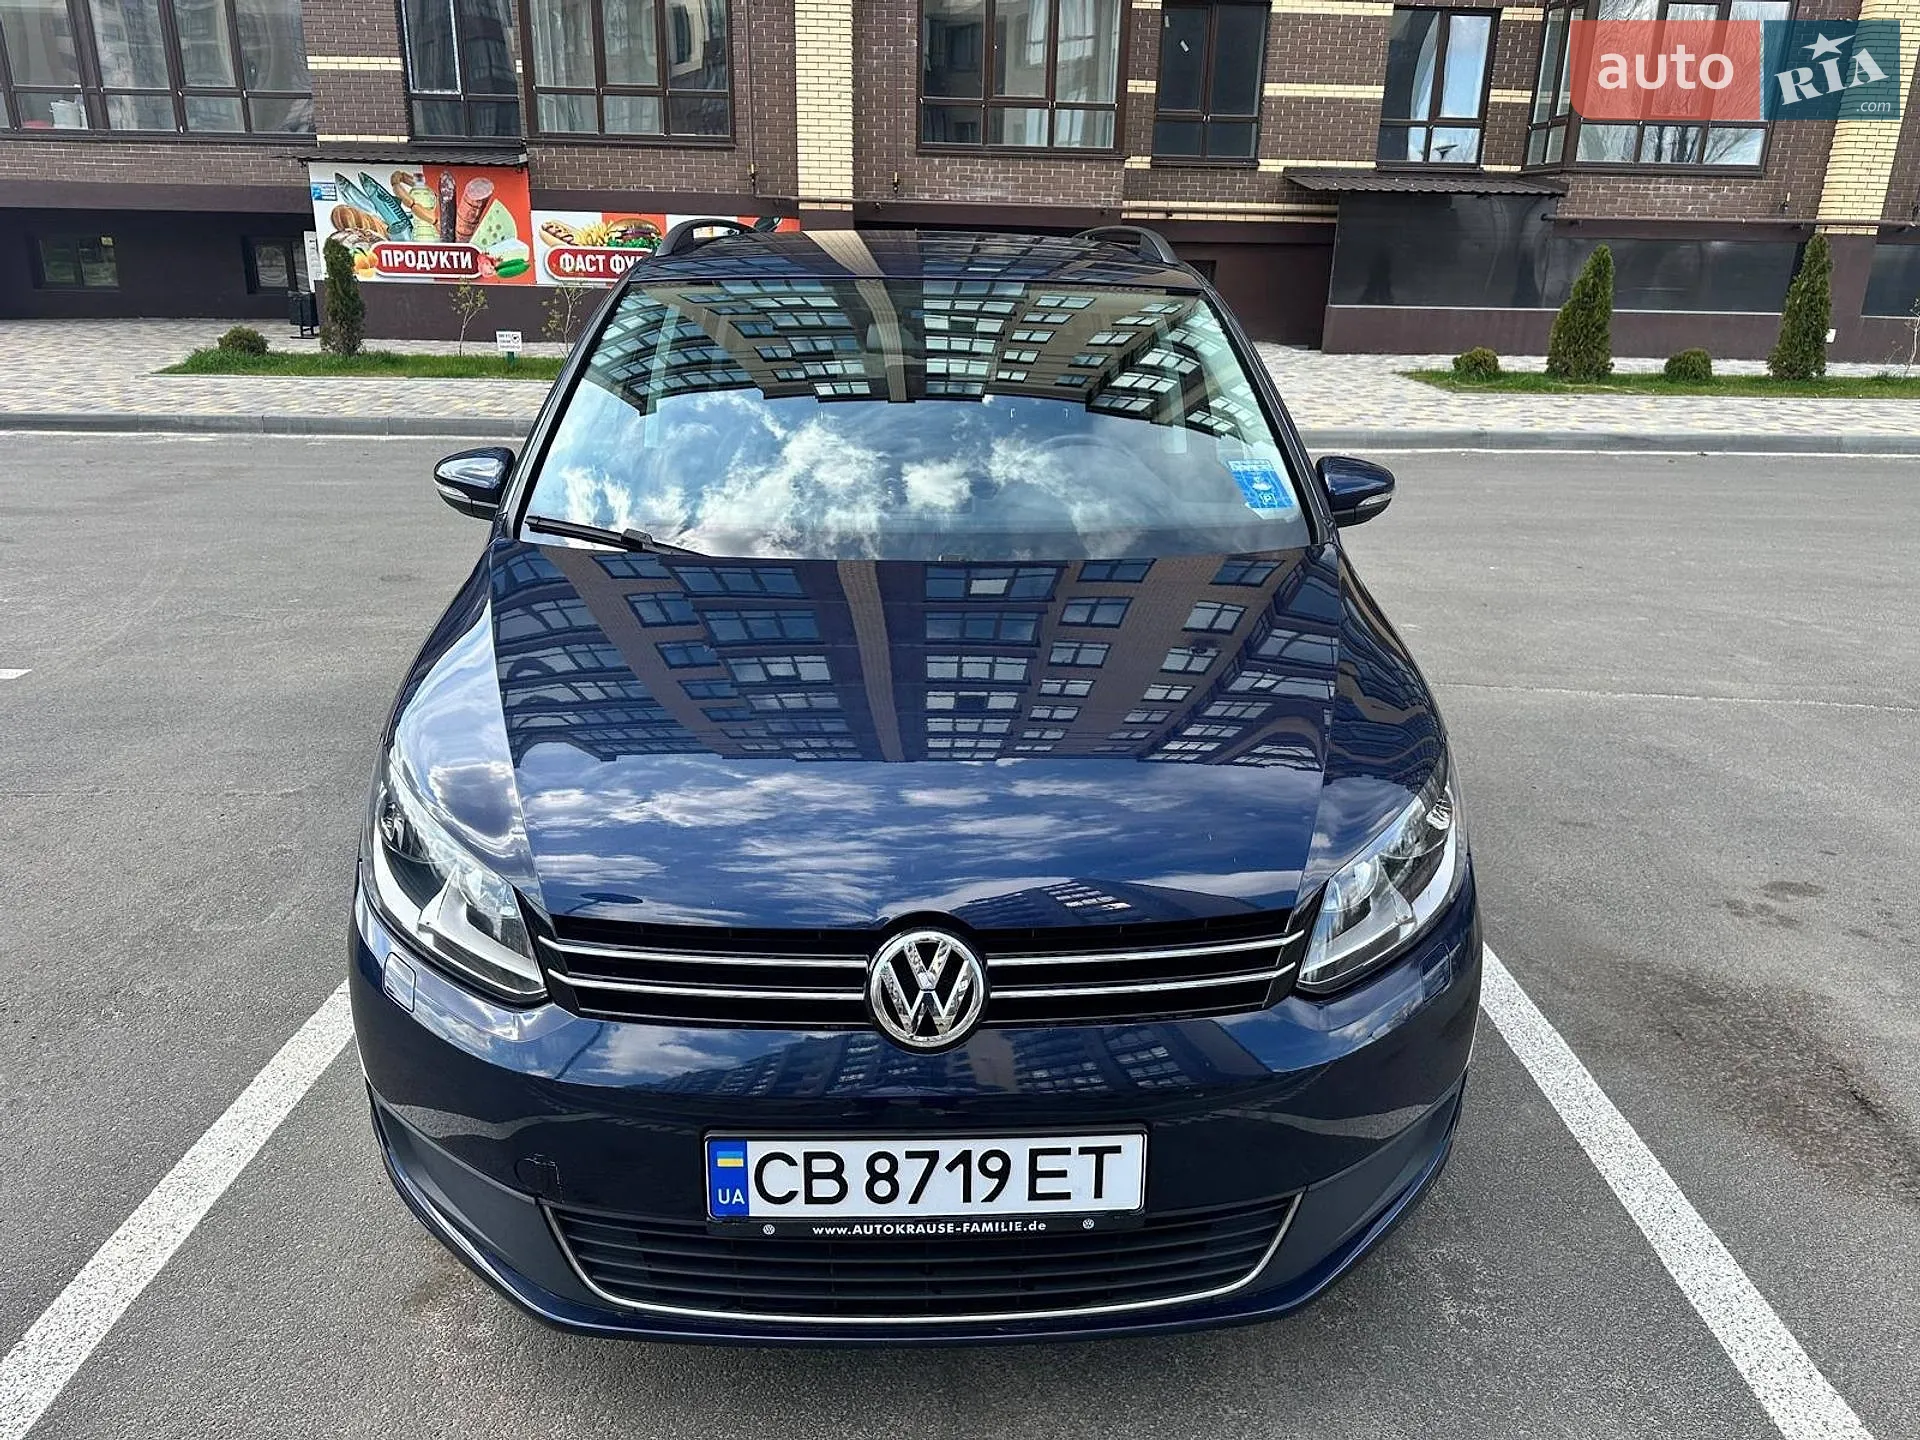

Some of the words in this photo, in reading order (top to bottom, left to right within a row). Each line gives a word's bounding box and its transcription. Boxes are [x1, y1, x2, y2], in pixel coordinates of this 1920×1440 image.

[380, 249, 473, 271] ПРОДУКТИ
[559, 252, 606, 273] ФАСТ
[610, 253, 643, 275] ФУ
[754, 1150, 849, 1206] CB
[865, 1149, 1012, 1205] 8719
[1027, 1144, 1122, 1201] ET
[718, 1188, 745, 1205] UA
[812, 1220, 1047, 1235] www.AUTOKRAUSE-FAMILIE.de
